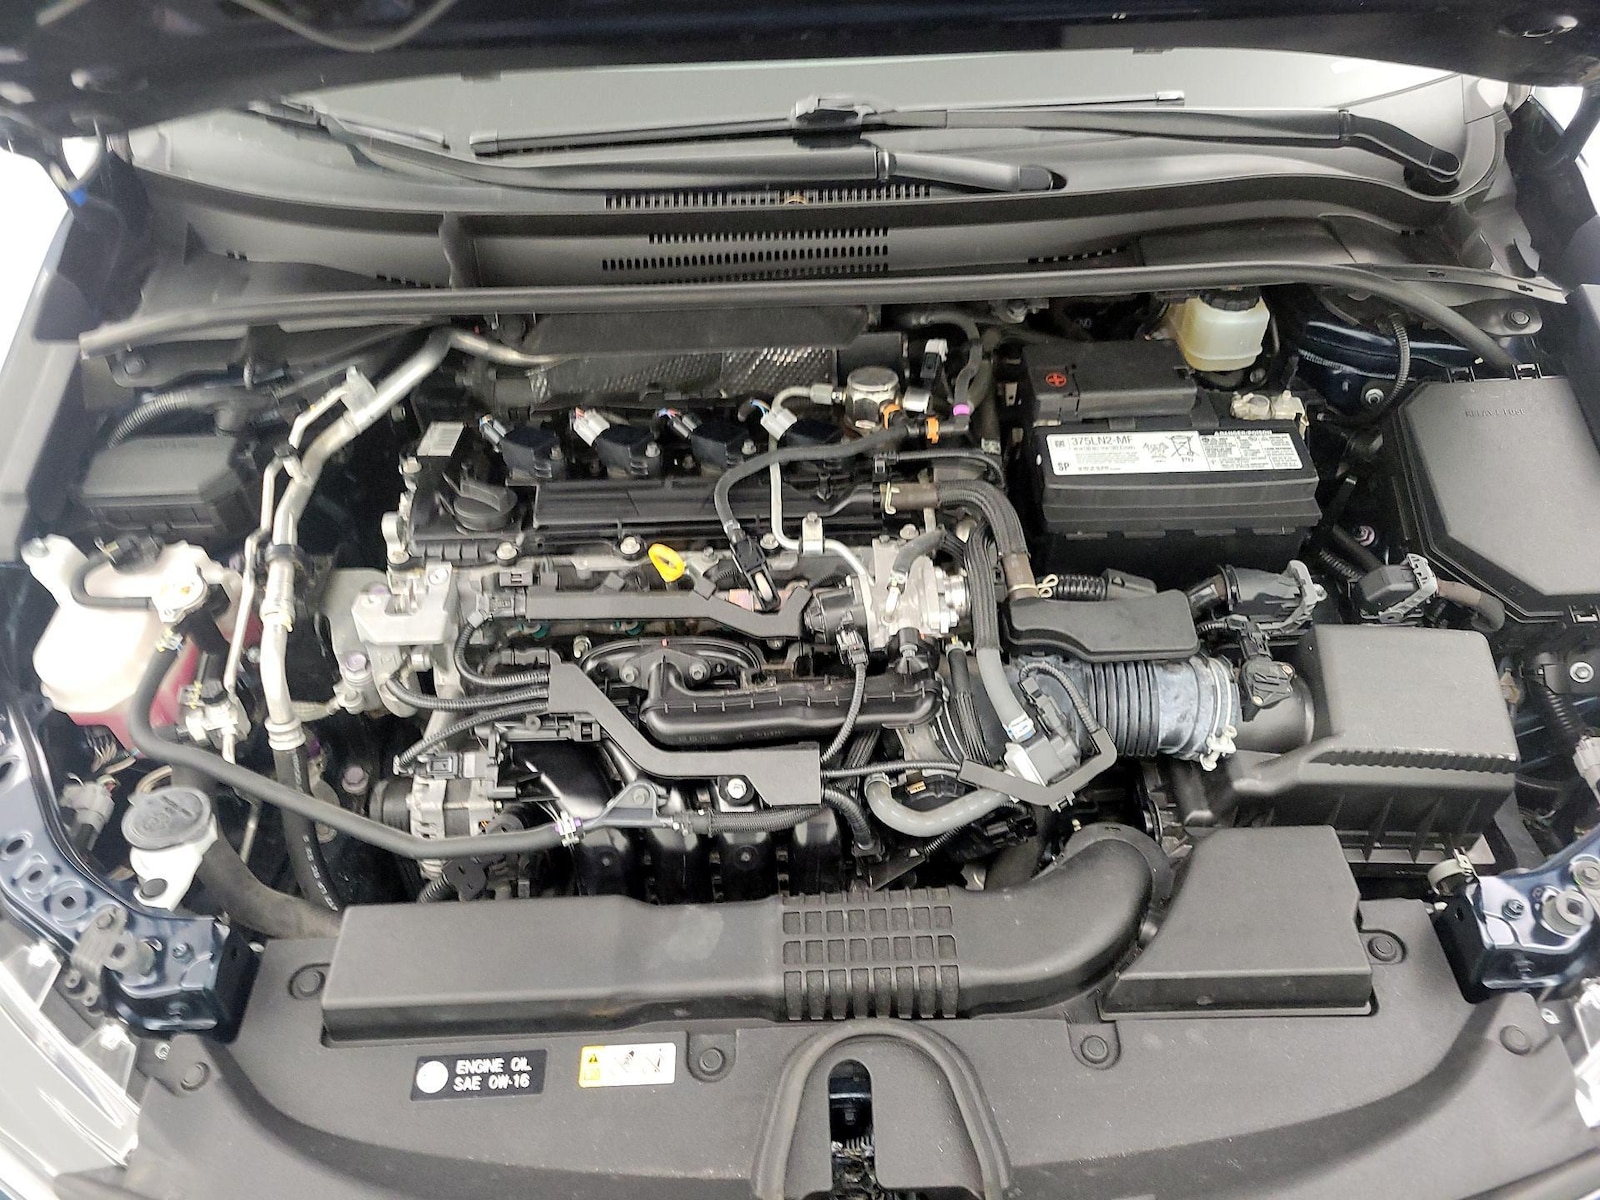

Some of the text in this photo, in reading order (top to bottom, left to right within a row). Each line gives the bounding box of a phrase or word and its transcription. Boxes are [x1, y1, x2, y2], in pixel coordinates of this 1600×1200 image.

[1071, 435, 1133, 446] 375LN2-MF
[1057, 462, 1070, 472] SP
[456, 1057, 532, 1074] ENGINE OIL
[453, 1073, 530, 1091] SAE 0W-16
